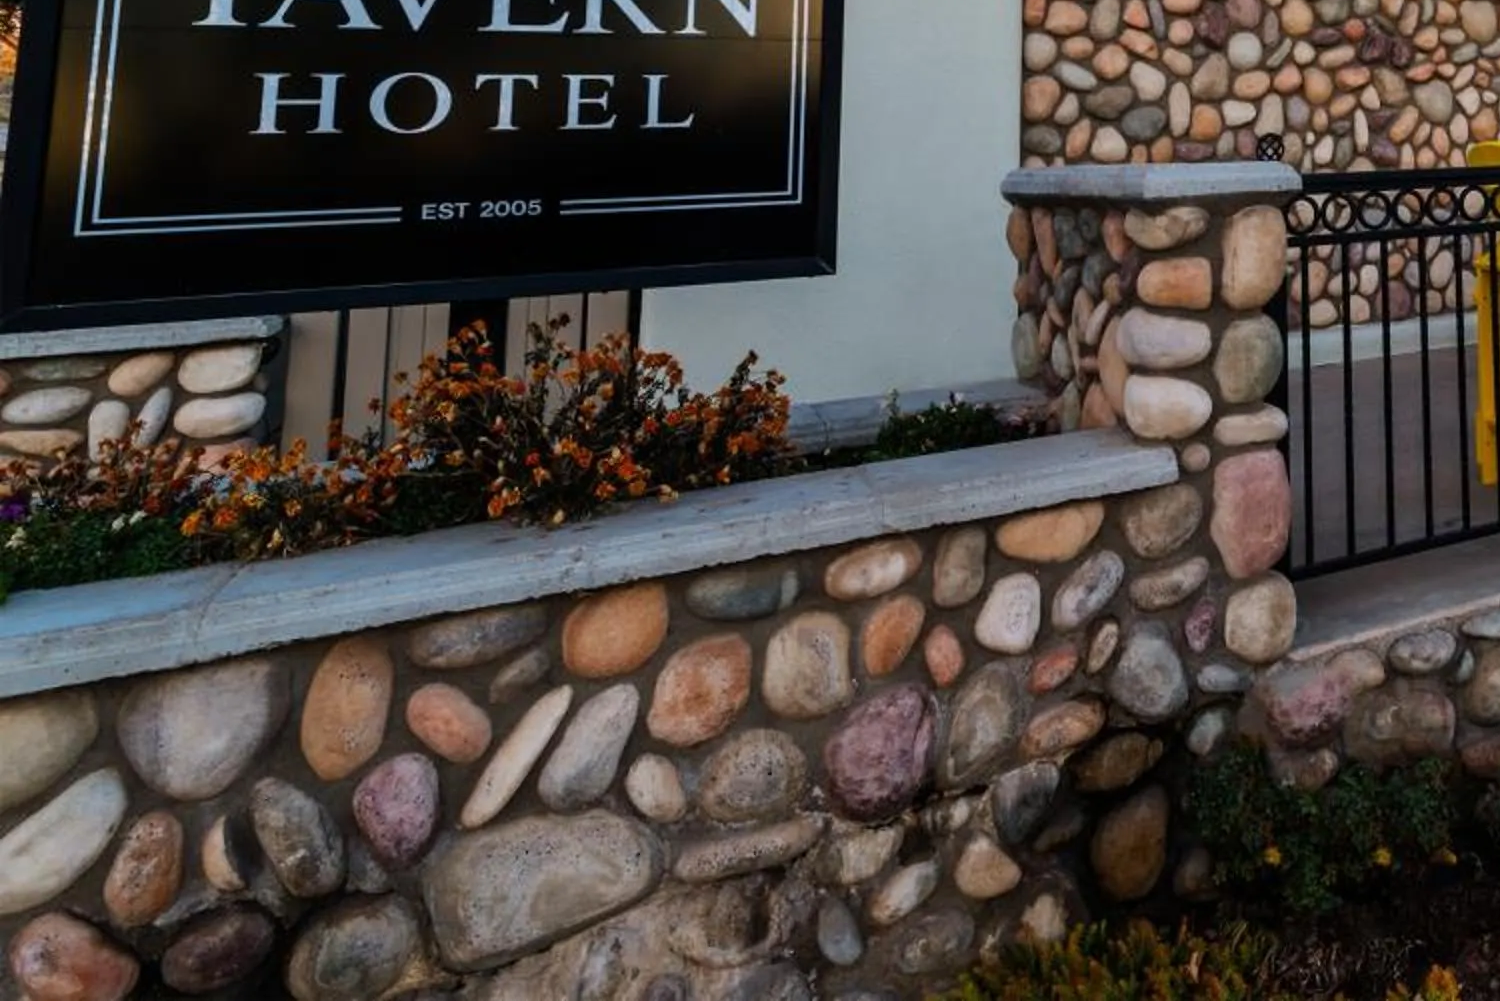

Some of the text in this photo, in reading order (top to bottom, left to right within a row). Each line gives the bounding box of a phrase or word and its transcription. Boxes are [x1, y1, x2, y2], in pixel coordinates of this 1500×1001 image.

[249, 72, 695, 135] HOTEL
[420, 200, 542, 220] EST 2005
